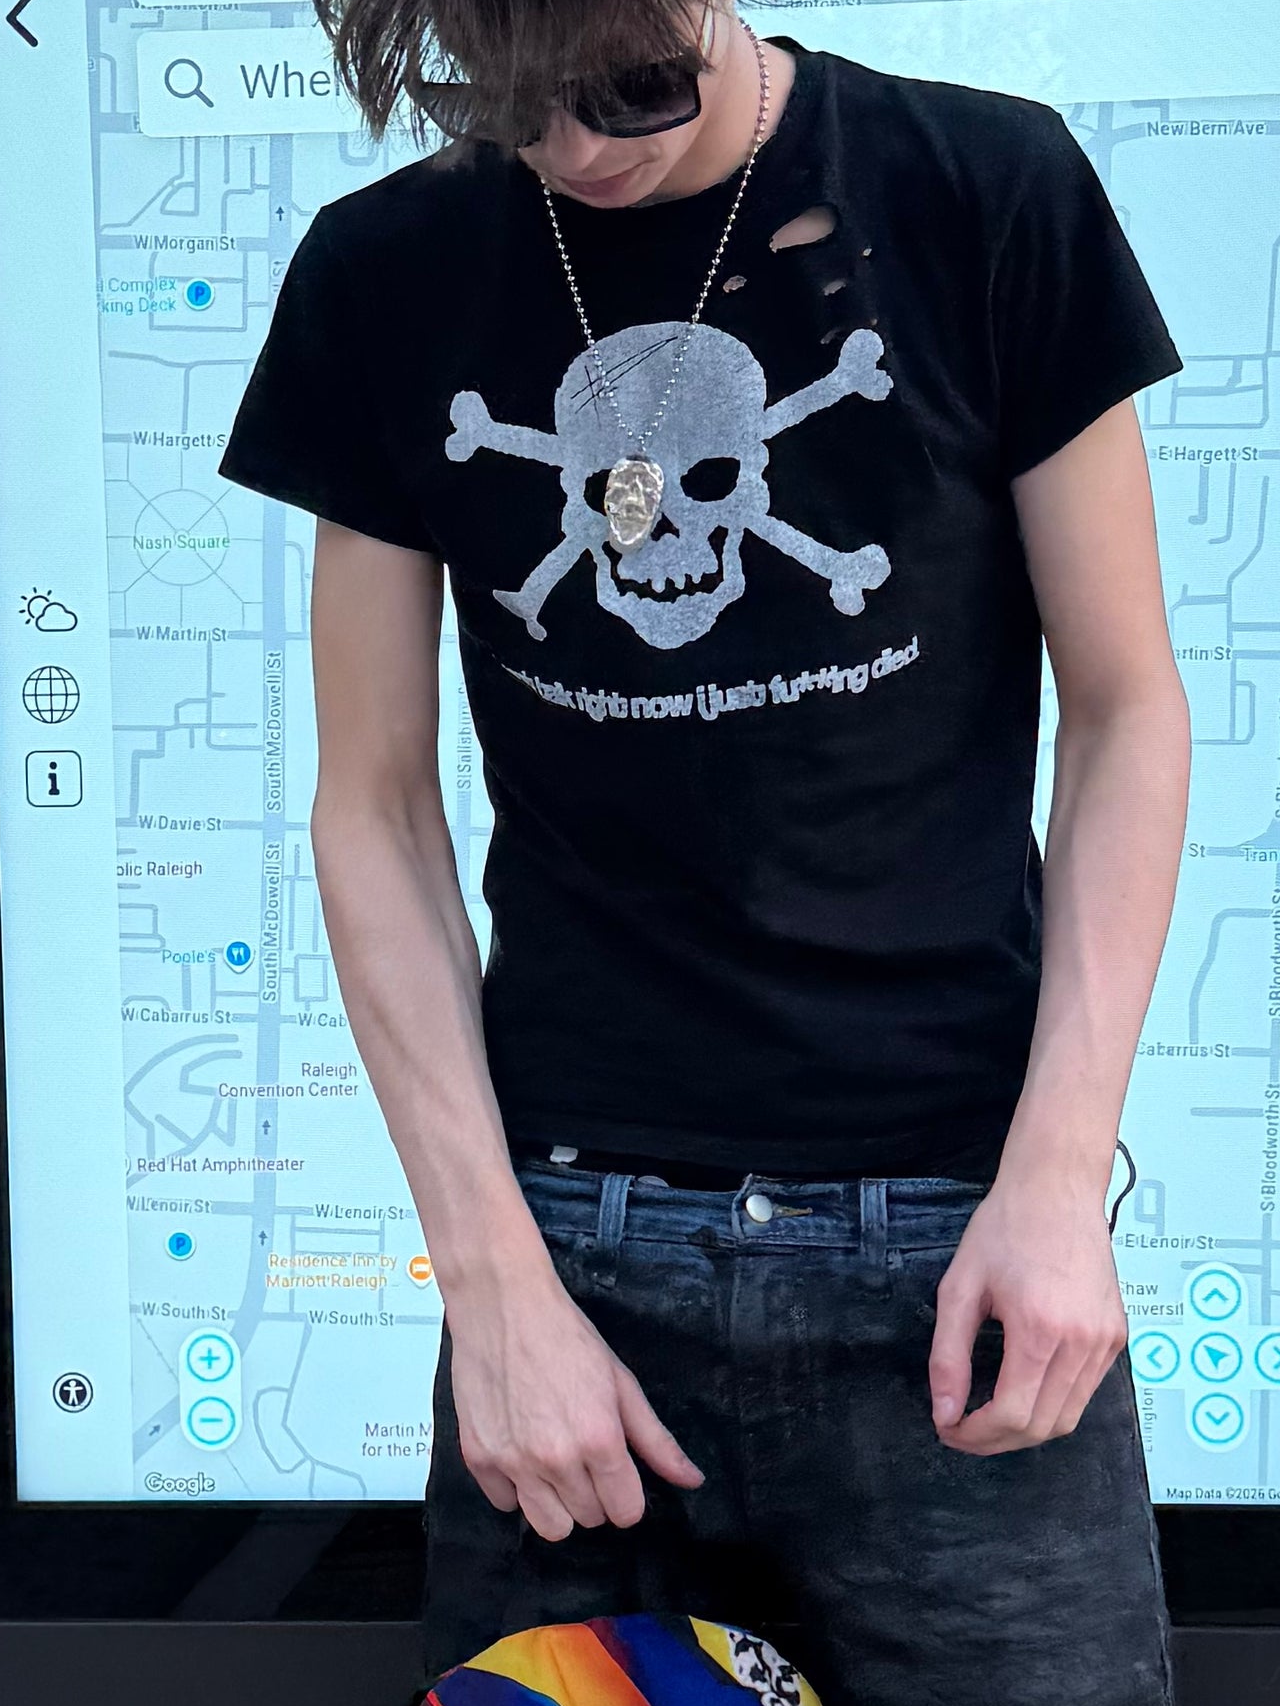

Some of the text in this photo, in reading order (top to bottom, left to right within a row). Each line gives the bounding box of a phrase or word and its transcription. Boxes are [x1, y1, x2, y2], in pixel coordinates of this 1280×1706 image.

[1147, 120, 1266, 136] New Bern Ave
[134, 235, 236, 254] W Morgan St
[108, 276, 177, 296] Complex
[137, 296, 177, 313] Deck
[133, 431, 214, 451] W Hargett
[1173, 446, 1258, 466] Hargett St
[133, 532, 231, 553] Nash Square
[136, 625, 228, 642] W Martin St
[1213, 645, 1232, 661] St
[575, 686, 629, 722] right
[630, 693, 694, 719] now
[871, 634, 920, 680] died
[266, 651, 283, 813] South McDowell St
[138, 815, 223, 832] W Davie St
[1188, 843, 1206, 859] St
[146, 860, 204, 879] Raleigh
[262, 842, 281, 1002] South McDowell St
[161, 948, 216, 964] Poole's
[121, 1007, 232, 1025] W Cabarrus St
[298, 1012, 315, 1028] W
[1213, 1043, 1231, 1058] St
[301, 1062, 358, 1080] Raleigh
[218, 1082, 359, 1098] Convention Center
[1260, 1083, 1280, 1196] Bloodworth St
[136, 1156, 306, 1176] Red Hat Amphitheater
[140, 1196, 212, 1215] Lenoir St
[315, 1204, 405, 1221] W Lenoir St
[1140, 1234, 1215, 1250] Lenoir St
[269, 1254, 398, 1271] Residence Inn by
[266, 1273, 388, 1292] Marriott Raleigh
[141, 1301, 227, 1321] W South St
[309, 1309, 395, 1327] W South St
[365, 1422, 416, 1438] Martin
[361, 1442, 413, 1457] for the
[144, 1471, 216, 1497] Google
[1166, 1488, 1193, 1501] Map
[1195, 1488, 1222, 1500] Data
